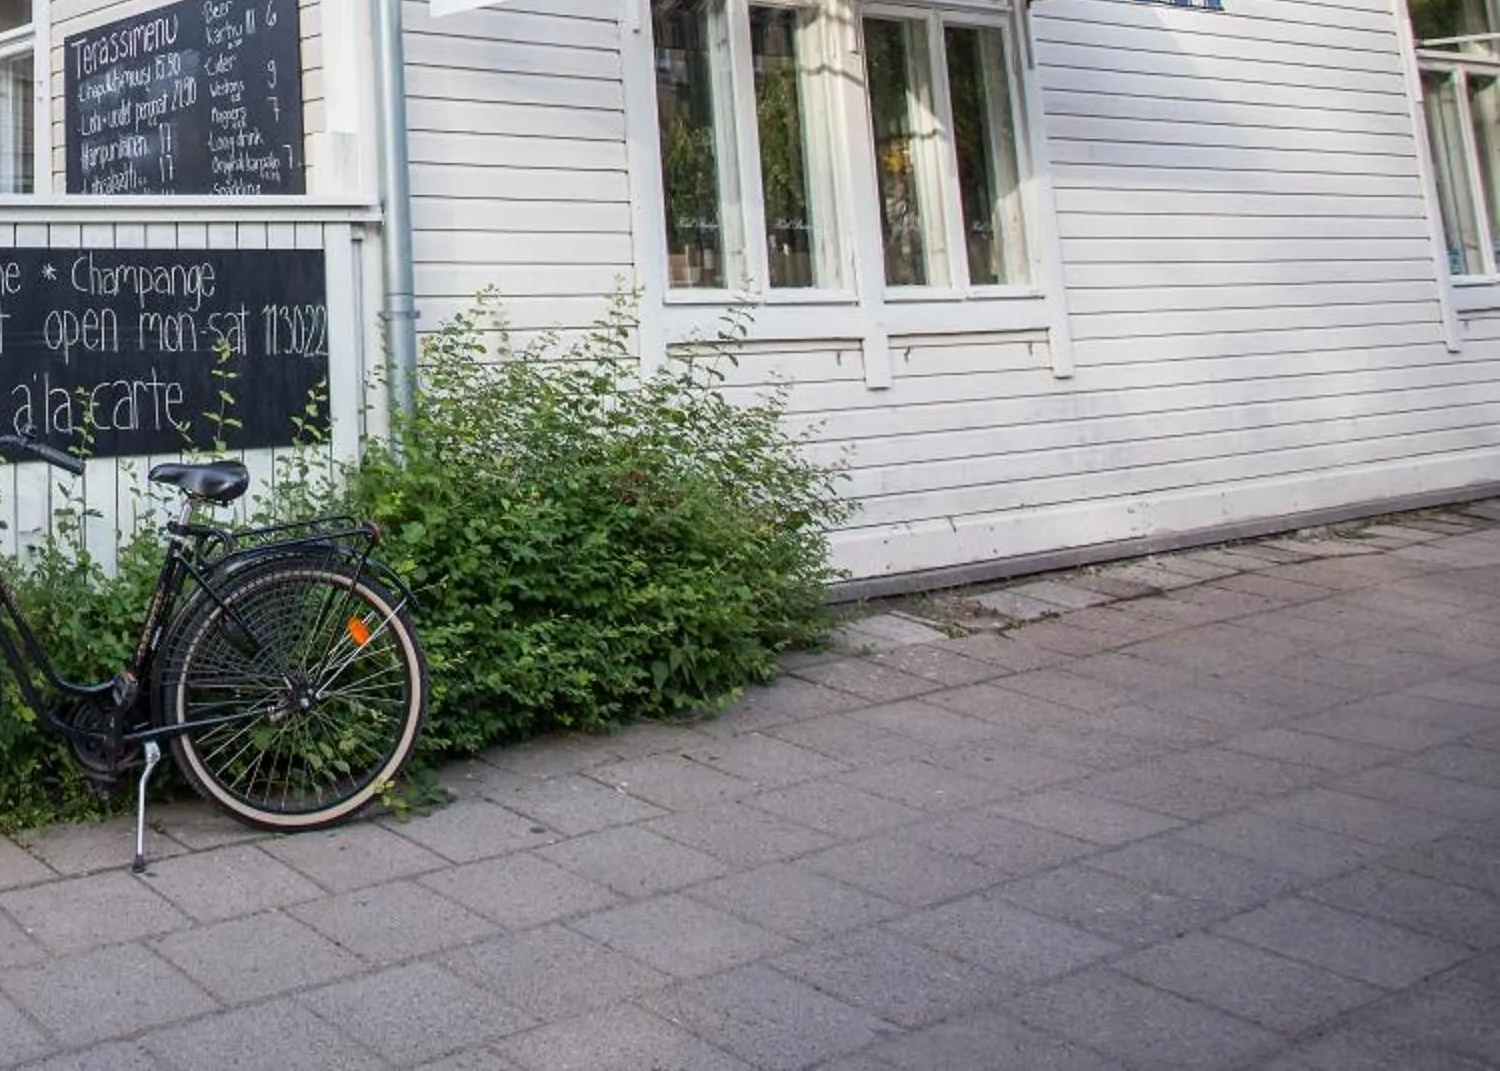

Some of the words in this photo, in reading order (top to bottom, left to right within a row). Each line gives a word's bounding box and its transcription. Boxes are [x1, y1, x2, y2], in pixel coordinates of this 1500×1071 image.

[71, 250, 215, 311] Champange
[44, 307, 119, 365] open
[90, 367, 183, 431] carte
